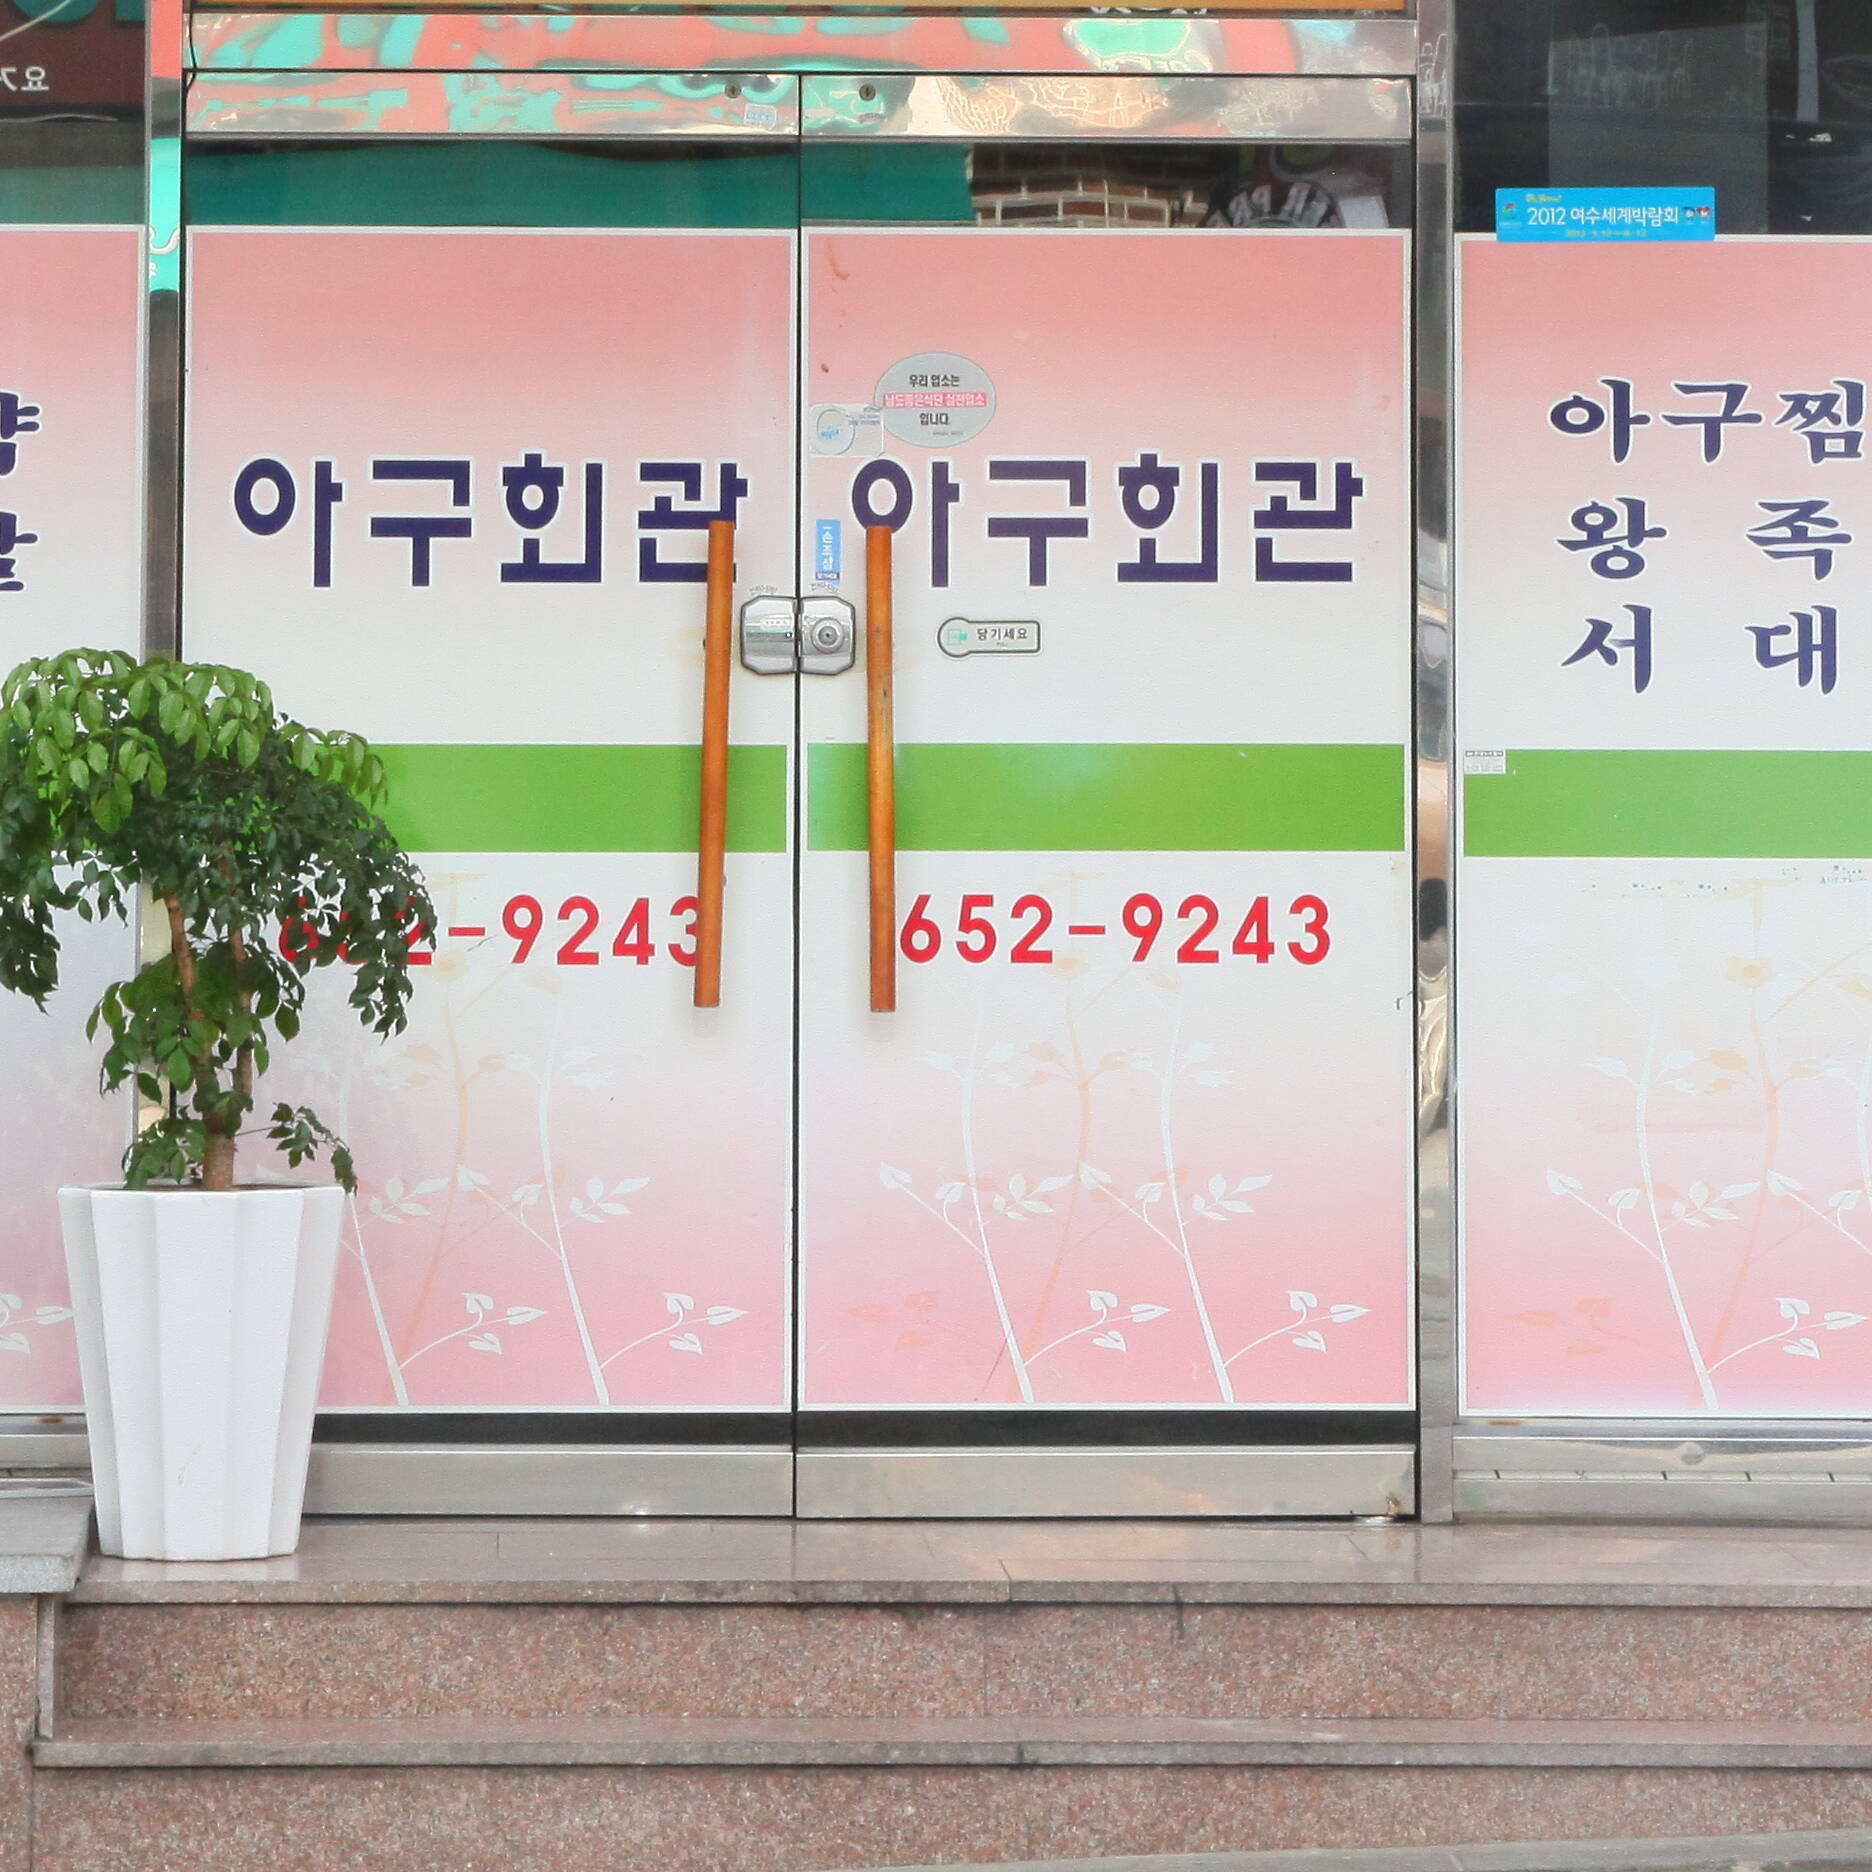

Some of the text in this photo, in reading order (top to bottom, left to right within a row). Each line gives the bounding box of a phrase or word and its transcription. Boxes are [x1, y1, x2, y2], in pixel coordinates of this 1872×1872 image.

[1527, 205, 1680, 227] 2012 여수세계박람회
[909, 374, 961, 388] 우리 업소는
[234, 453, 748, 588] 아구회관
[851, 453, 1363, 588] 아구회관
[977, 628, 1028, 641] 당기세요
[900, 893, 1331, 966] 652-9243
